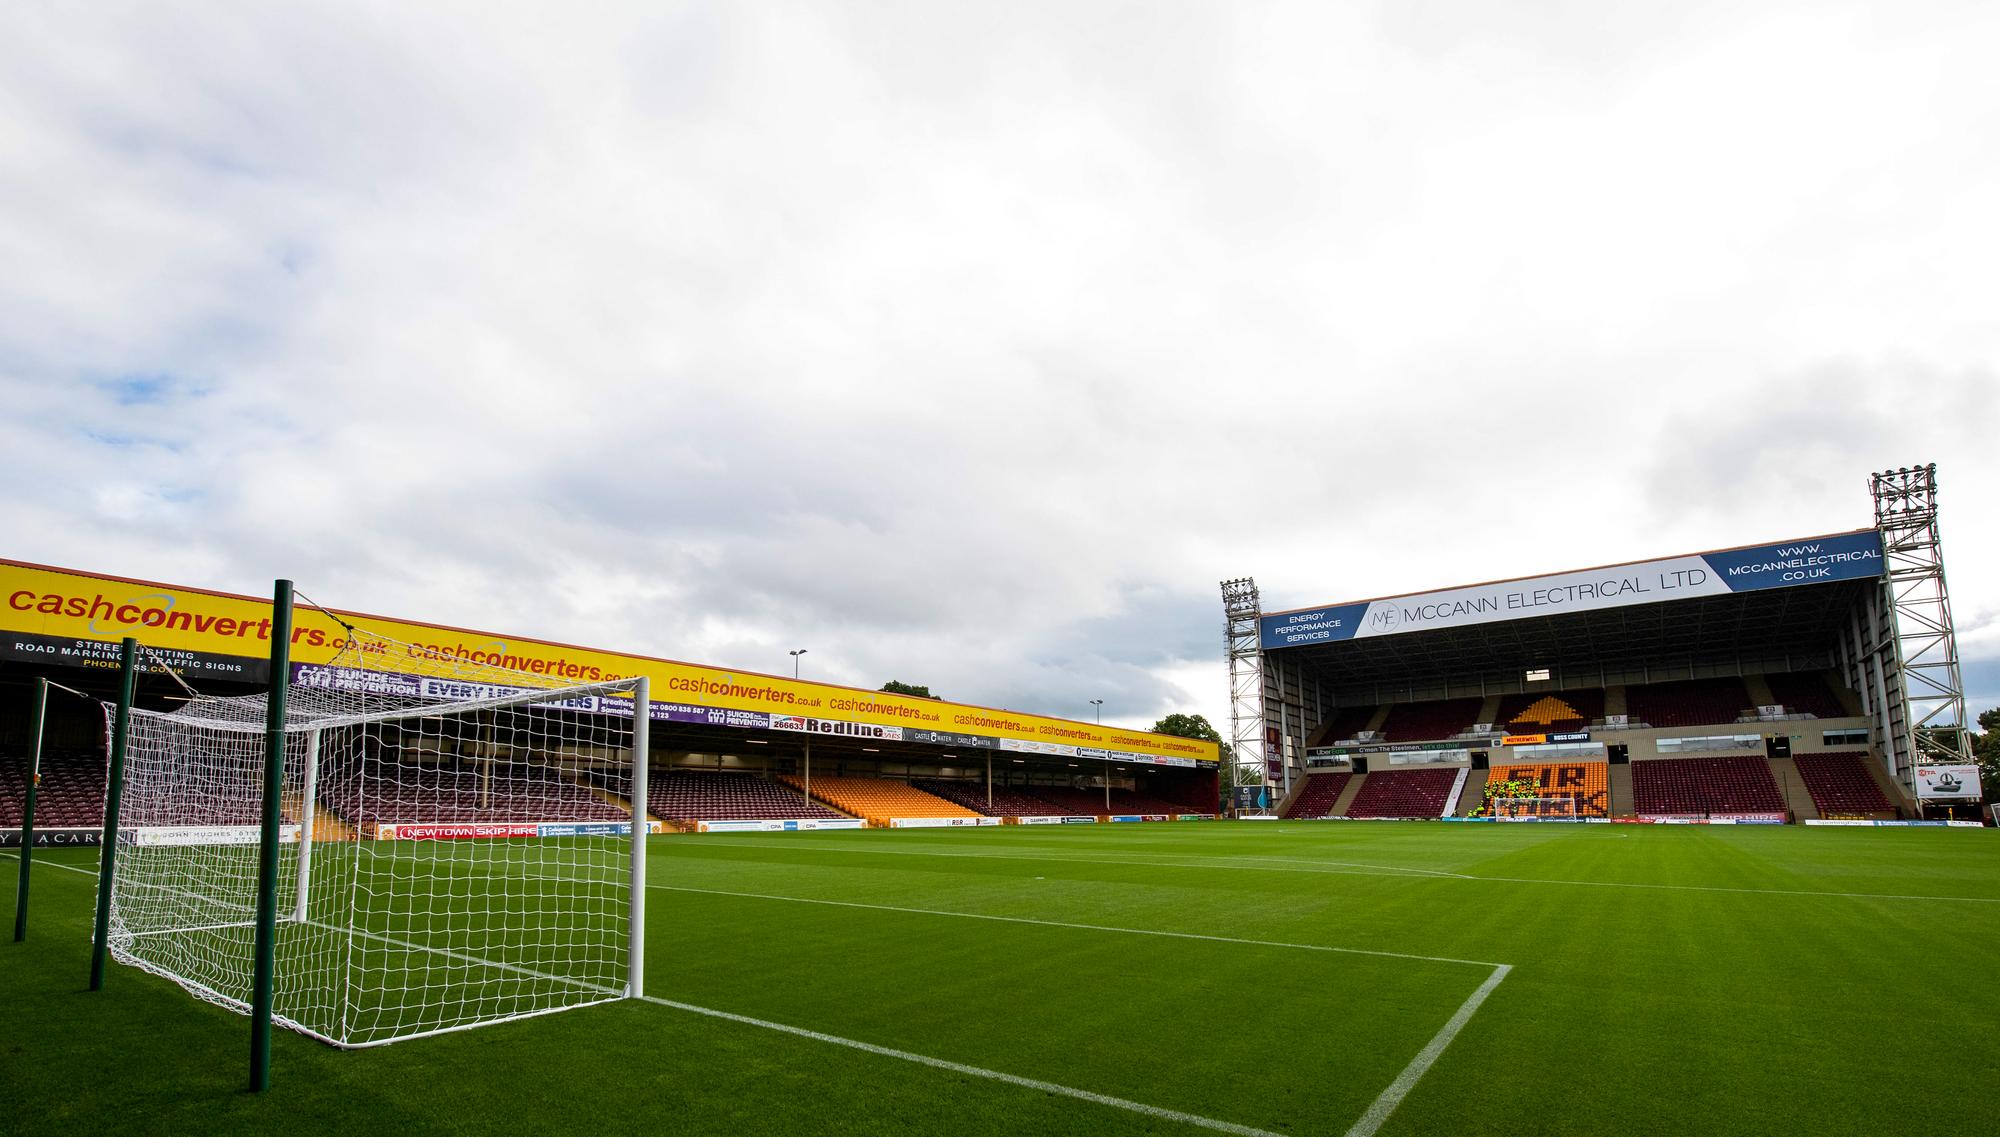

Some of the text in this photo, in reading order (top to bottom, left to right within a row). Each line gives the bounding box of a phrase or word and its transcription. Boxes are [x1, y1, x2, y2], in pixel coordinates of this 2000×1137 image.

[1729, 549, 1882, 576] MCCANNELECTRICAL
[1779, 567, 1830, 582] .CO.UK
[1404, 569, 1706, 622] MCCANN ELECTRICAL LTD
[1289, 612, 1325, 623] ENERGY
[1275, 620, 1341, 634] PERFORMANCE
[1287, 631, 1330, 642] SERVICES
[76, 640, 123, 651] STREE
[15, 642, 55, 654] ROAD
[148, 656, 200, 668] TRAFFIC
[205, 662, 242, 672] SIGNS
[336, 669, 389, 683] SUICIDE
[335, 679, 416, 694] PREVENTION
[428, 682, 483, 698] EVERY
[669, 677, 822, 708] cashconverters.co.uk
[660, 704, 678, 712] 0800
[727, 711, 754, 720] SUICIDE
[829, 697, 940, 722] cashconverters.co.uk
[727, 718, 768, 728] PREVENTION
[774, 720, 804, 730] 266633
[807, 718, 883, 738] Redline
[954, 713, 1035, 733] cashconverters.co.uk
[937, 734, 952, 742] WATER
[1039, 725, 1102, 742] cashconverters.co.uk
[408, 827, 538, 836] NEWTOWN SKIP HIRE
